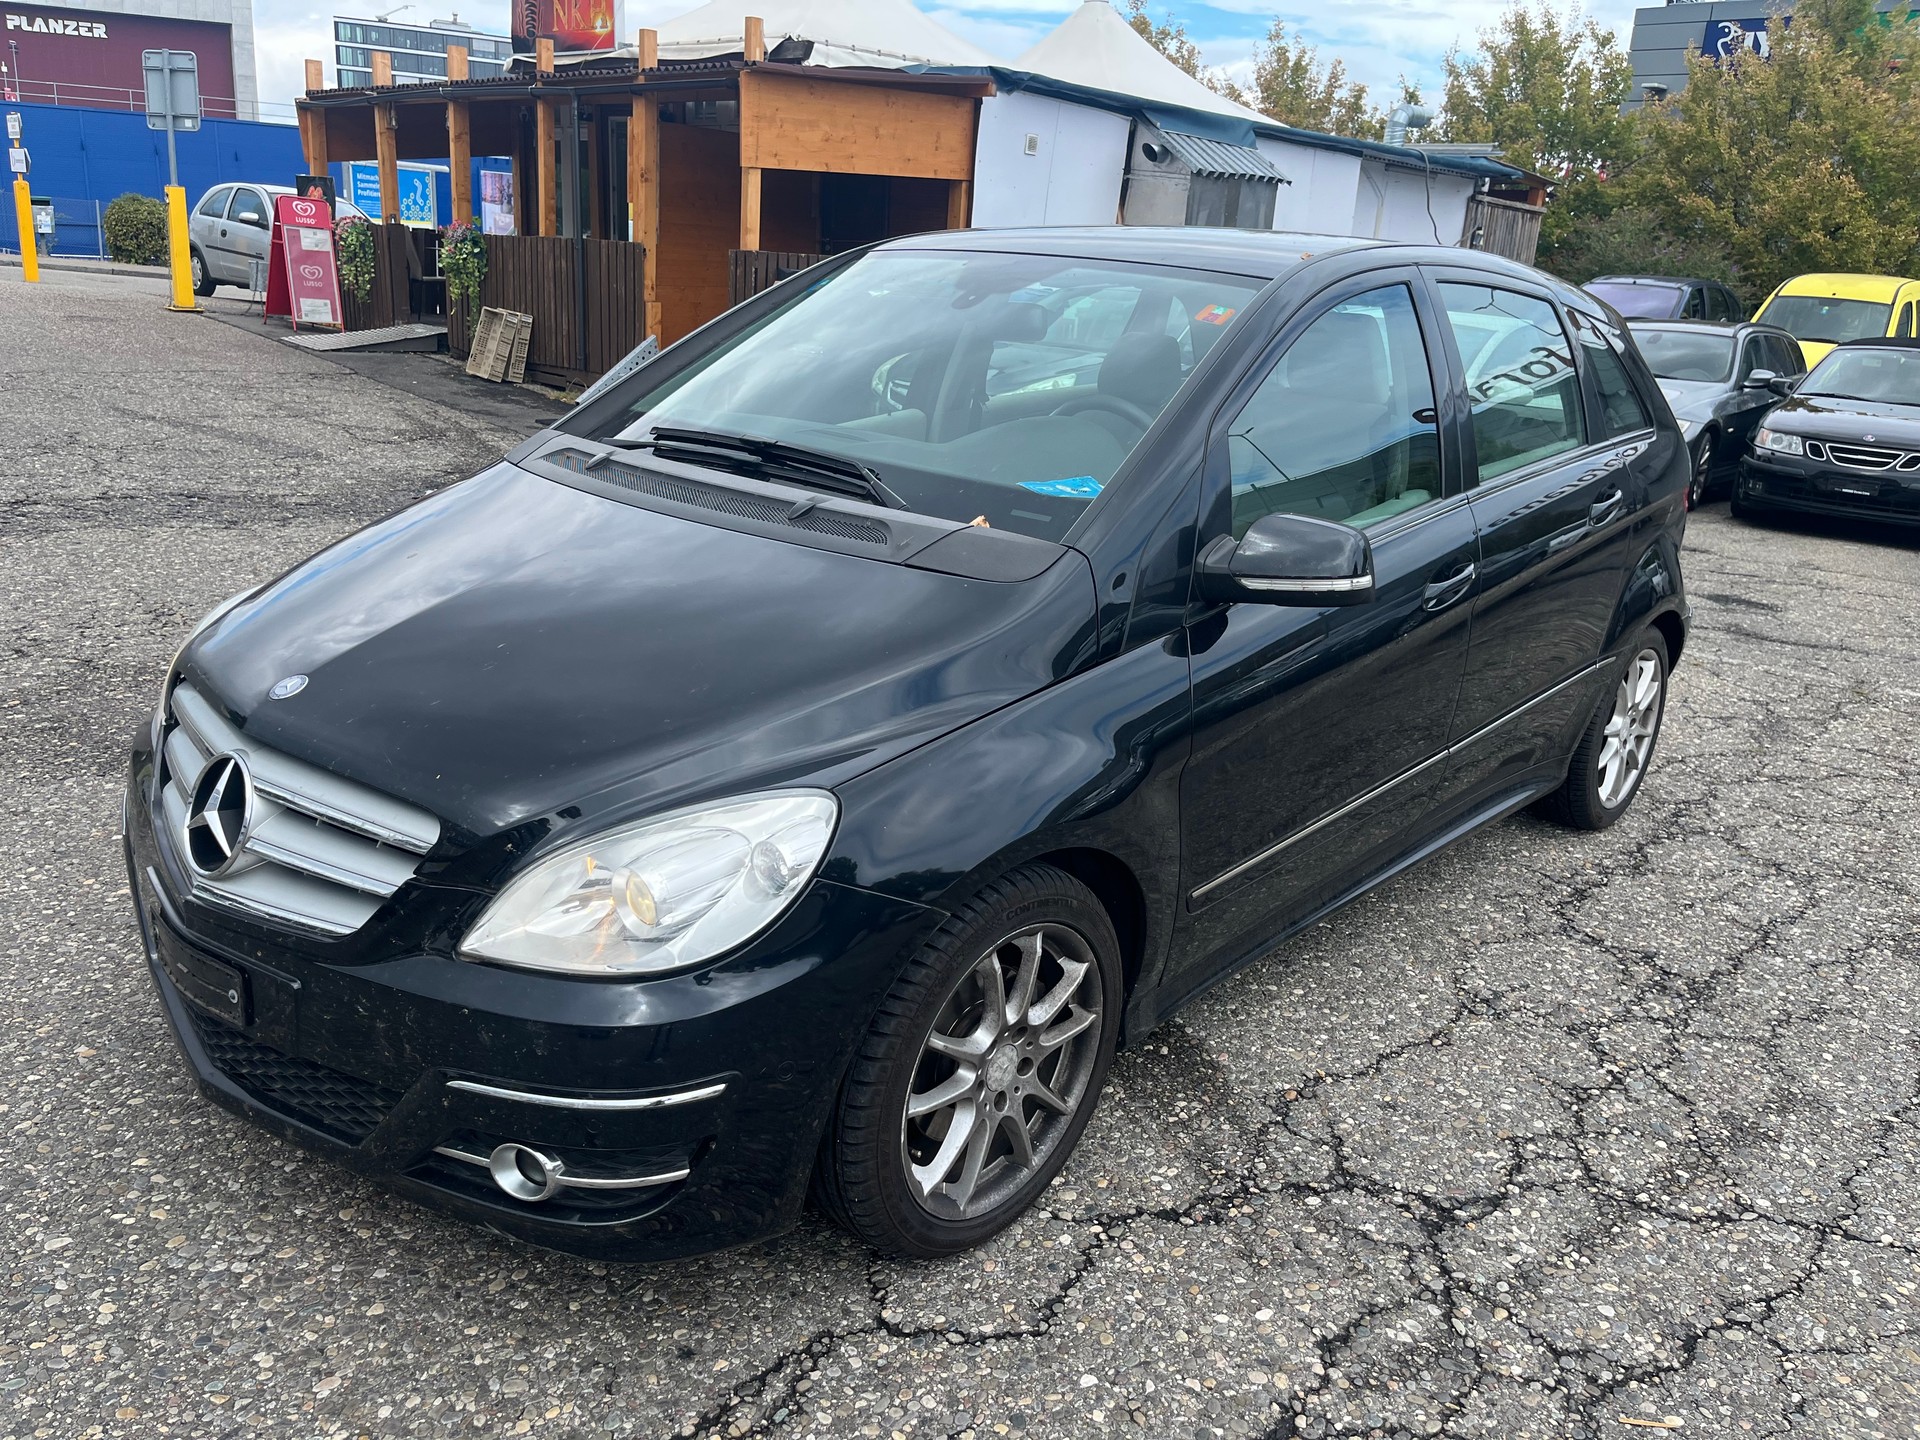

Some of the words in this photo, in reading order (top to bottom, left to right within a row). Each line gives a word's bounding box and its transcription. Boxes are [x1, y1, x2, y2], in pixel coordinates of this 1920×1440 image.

[5, 14, 108, 39] PLANZER
[295, 216, 316, 225] LUSSO
[303, 280, 323, 288] LUSSO
